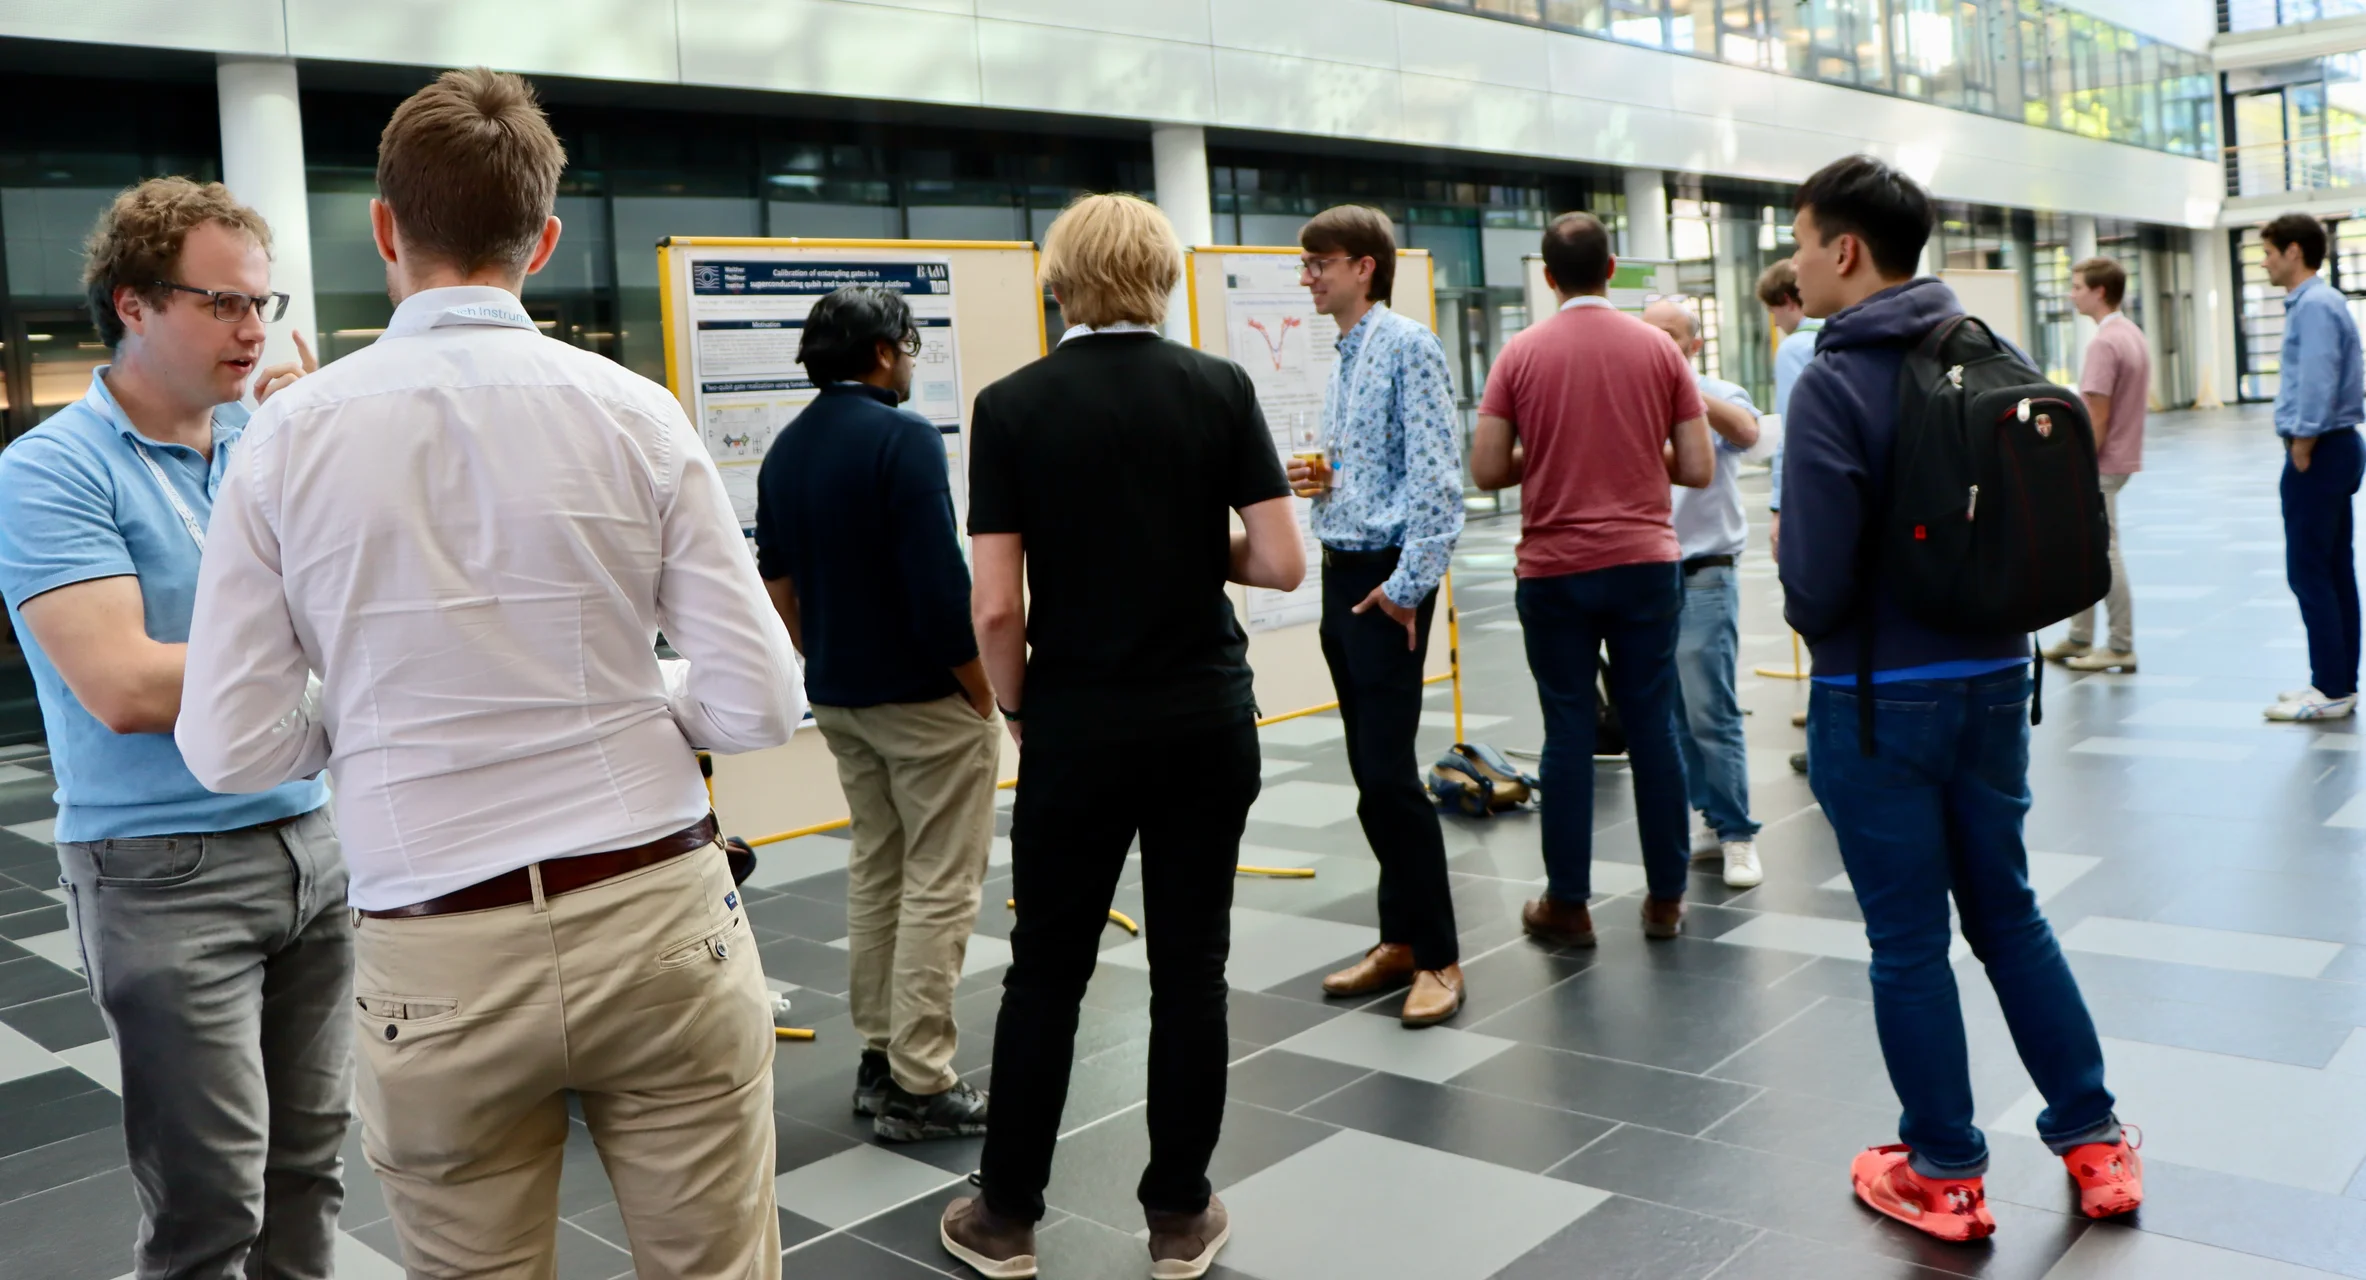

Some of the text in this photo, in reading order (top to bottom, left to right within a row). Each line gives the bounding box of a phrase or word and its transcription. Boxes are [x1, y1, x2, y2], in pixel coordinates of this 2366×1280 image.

[772, 268, 808, 277] Calibration
[809, 268, 817, 277] of
[817, 269, 850, 279] entangling
[850, 270, 867, 279] gates
[867, 269, 874, 277] in
[749, 280, 804, 289] superconducting
[804, 280, 822, 289] qubit
[885, 280, 912, 289] platform
[751, 320, 782, 328] Motivation
